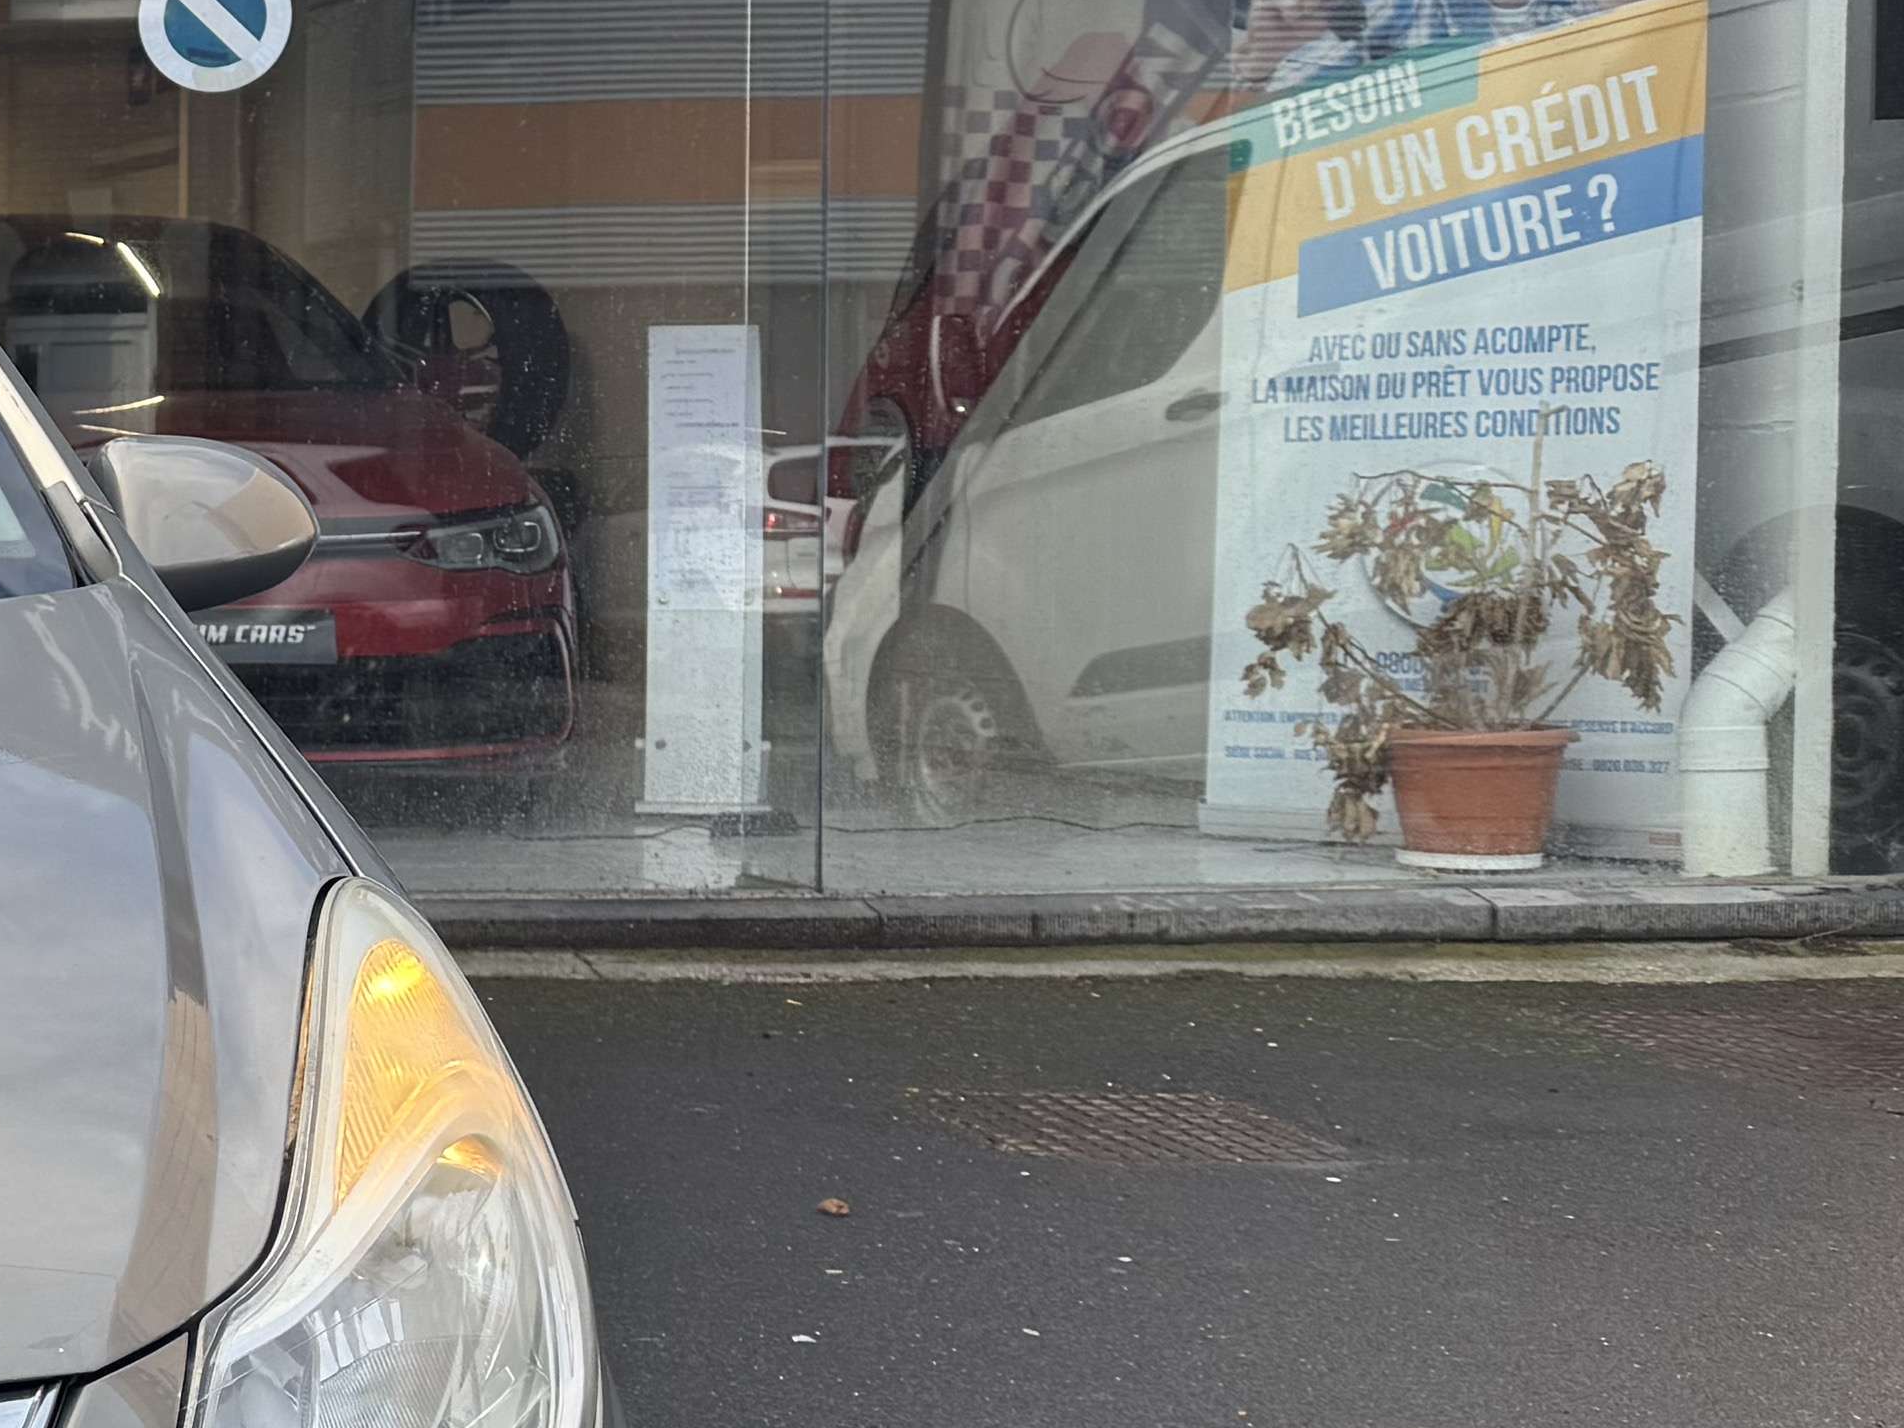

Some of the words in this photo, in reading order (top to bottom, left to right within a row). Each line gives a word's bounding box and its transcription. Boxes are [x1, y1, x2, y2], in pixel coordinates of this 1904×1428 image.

[1271, 60, 1424, 149] BESOIN
[1316, 128, 1446, 221] D'UN
[1455, 66, 1659, 181] CRÉDIT
[1362, 183, 1581, 291] VOITURE
[1586, 173, 1619, 233] ?
[1308, 333, 1366, 363] AVEC
[1371, 331, 1402, 360] OU
[1406, 328, 1468, 358] SANS
[1473, 323, 1597, 356] ACOMPTE,
[1251, 379, 1280, 405] LA
[1285, 374, 1370, 403] MAISON
[1376, 372, 1407, 400] DU
[1411, 364, 1472, 399] PRÊT
[1478, 368, 1544, 397] VOUS
[1550, 362, 1661, 395] PROPOSE
[1283, 415, 1323, 443] LES
[1329, 410, 1468, 442] MEILLEURES
[234, 624, 306, 644] CARS
